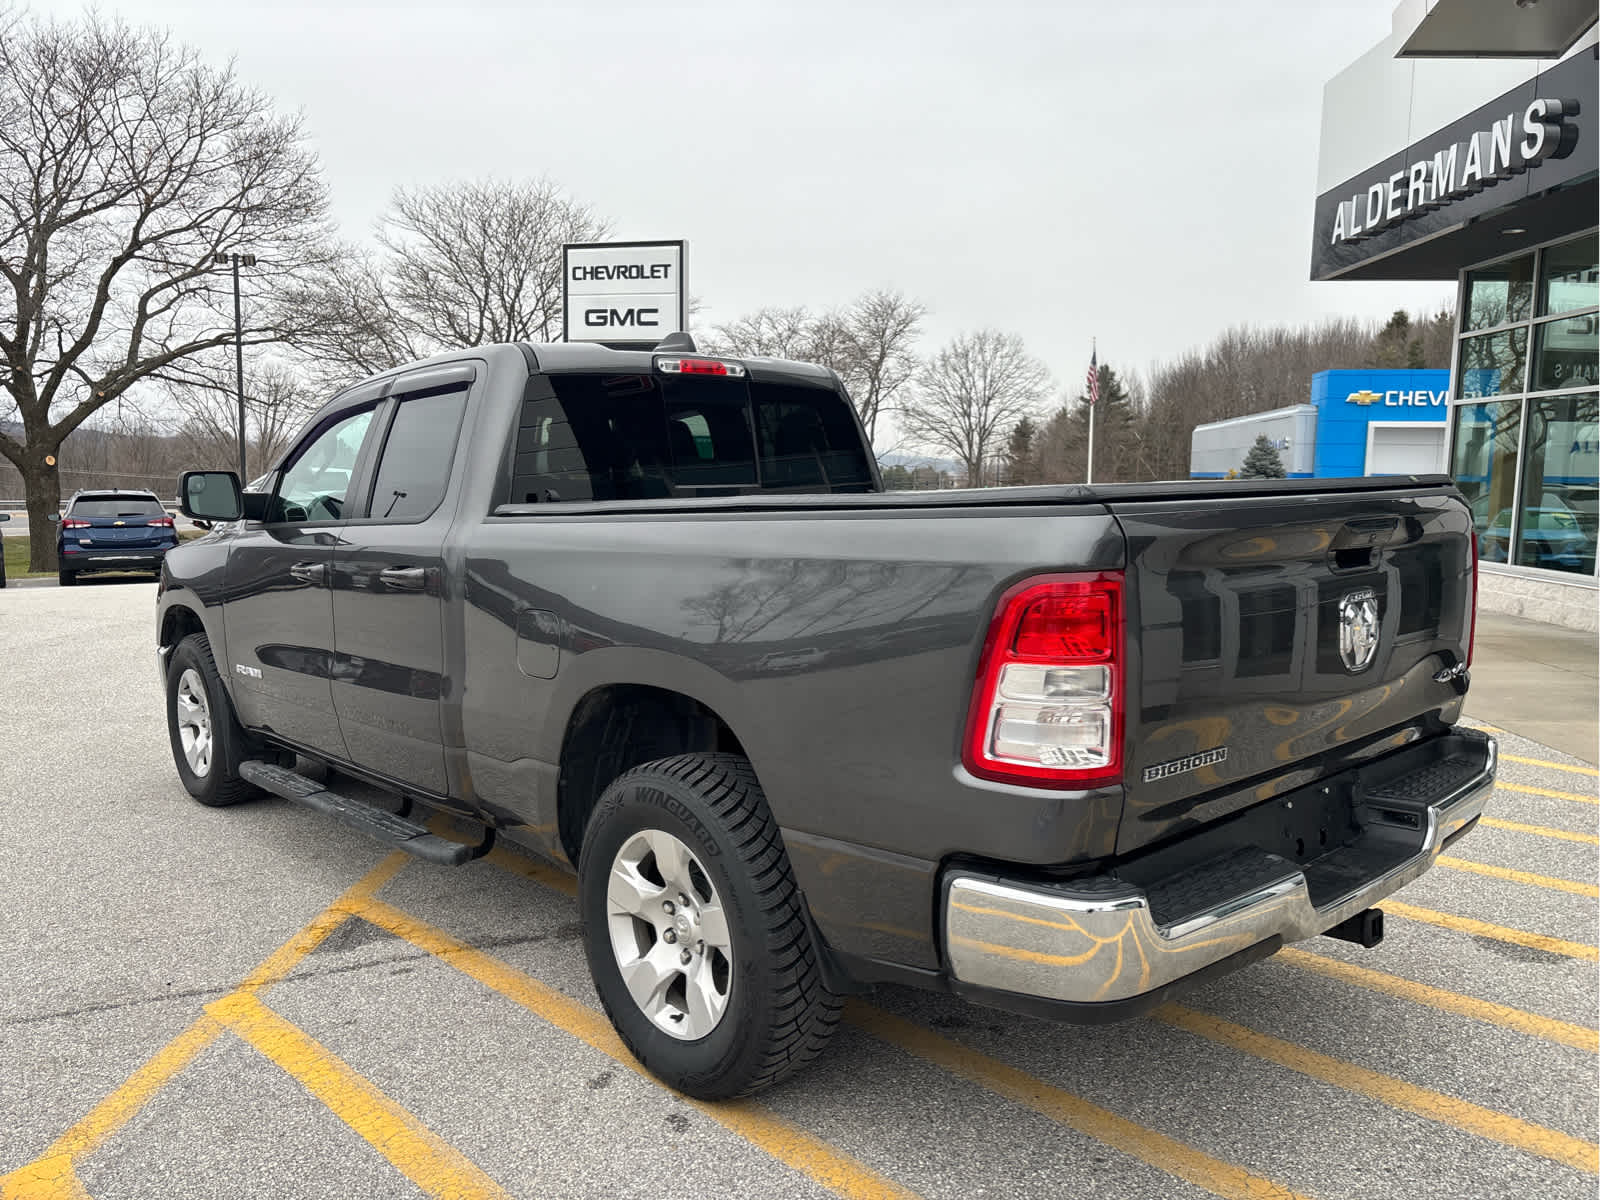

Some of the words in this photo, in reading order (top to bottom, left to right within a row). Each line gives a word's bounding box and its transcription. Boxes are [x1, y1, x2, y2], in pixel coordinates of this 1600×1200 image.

[1332, 98, 1560, 245] ALDERMANS
[572, 264, 671, 281] CHEVROLET
[584, 308, 659, 327] GMC
[1143, 746, 1228, 782] BIGHORN
[635, 786, 722, 856] WINGUARD
